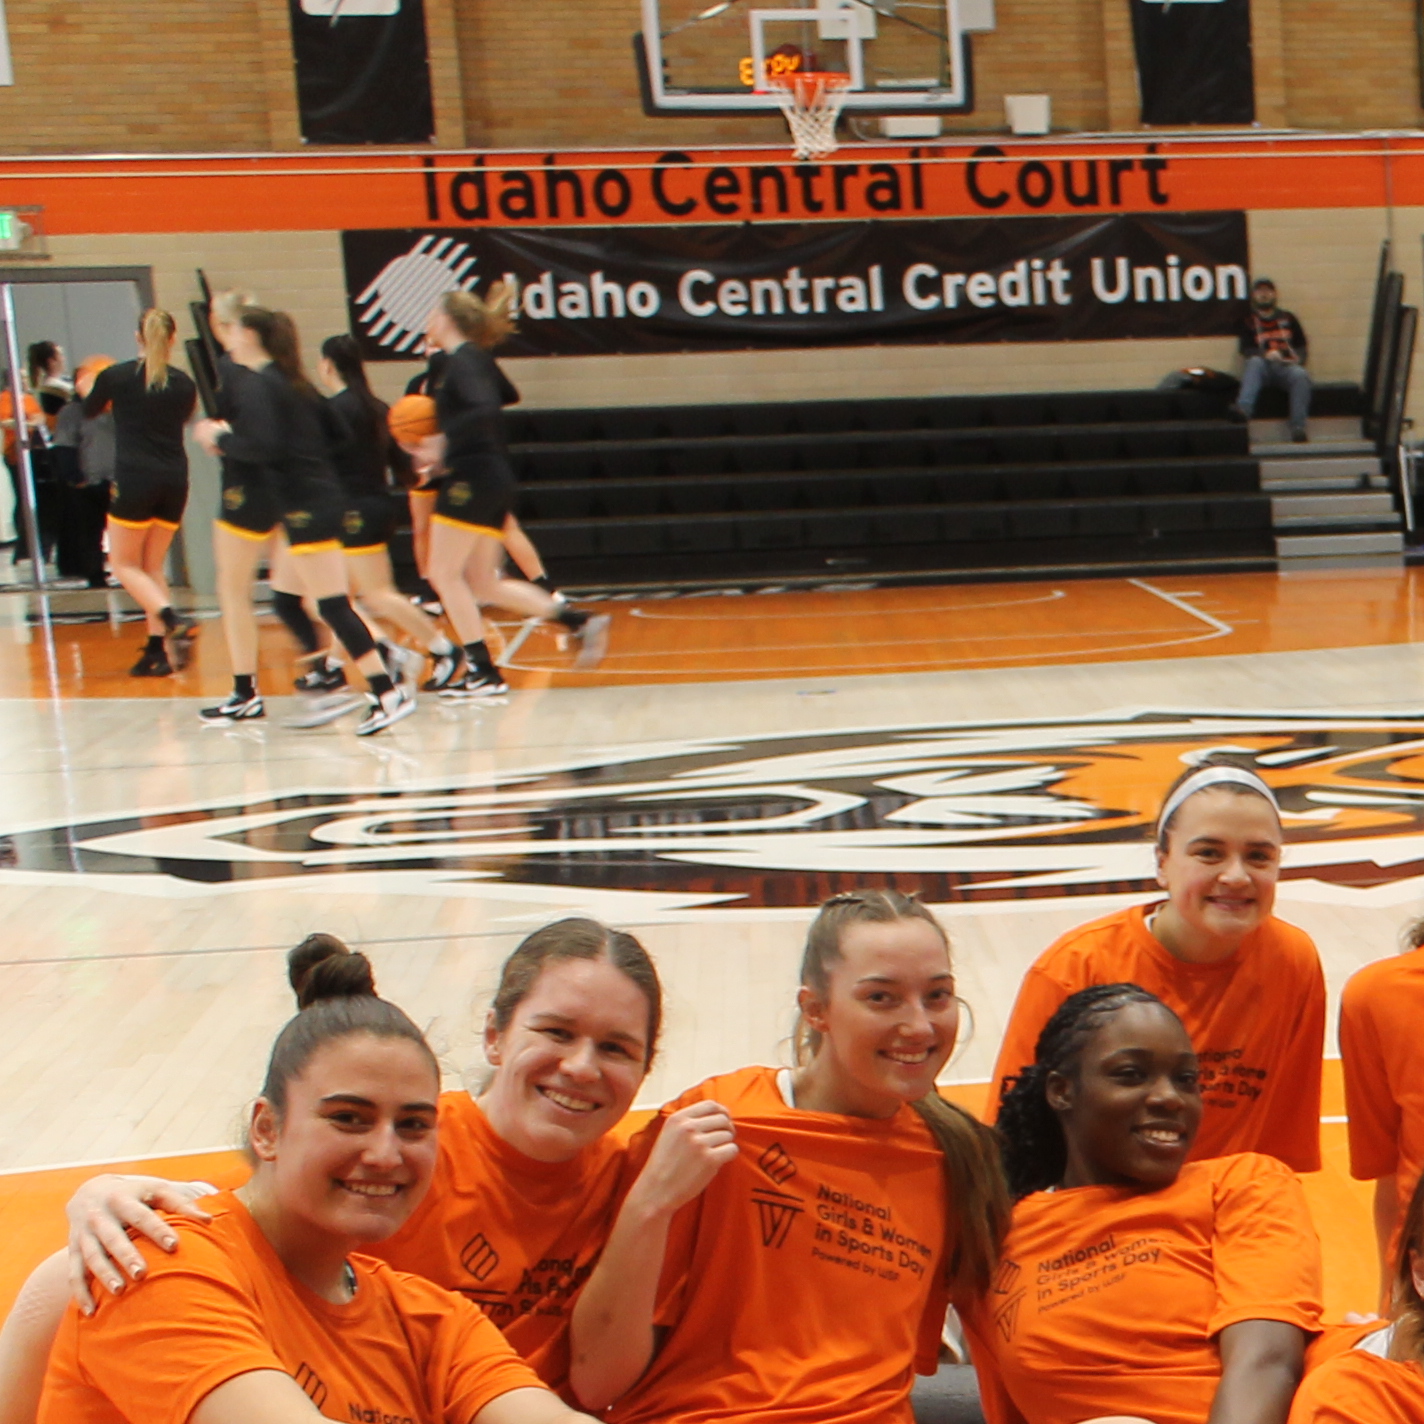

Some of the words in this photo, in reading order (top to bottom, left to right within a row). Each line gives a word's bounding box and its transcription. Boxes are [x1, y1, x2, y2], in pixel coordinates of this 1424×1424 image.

[421, 155, 633, 221] Idaho
[650, 147, 925, 216] Central
[965, 143, 1169, 210] Court
[502, 271, 661, 320] Idaho
[679, 265, 885, 317] Central
[902, 258, 1073, 310] Credit
[1090, 254, 1248, 304] Union
[818, 1184, 892, 1221] National
[815, 1223, 831, 1242] in
[837, 1230, 893, 1262] Sports
[899, 1251, 925, 1280] Day
[817, 1204, 856, 1229] Girls
[863, 1218, 874, 1236] &
[880, 1223, 932, 1258] Women
[1038, 1234, 1117, 1272] National
[1037, 1288, 1052, 1300] in
[1058, 1262, 1116, 1292] Sports
[1123, 1248, 1161, 1266] Day
[1037, 1267, 1079, 1285] Girls
